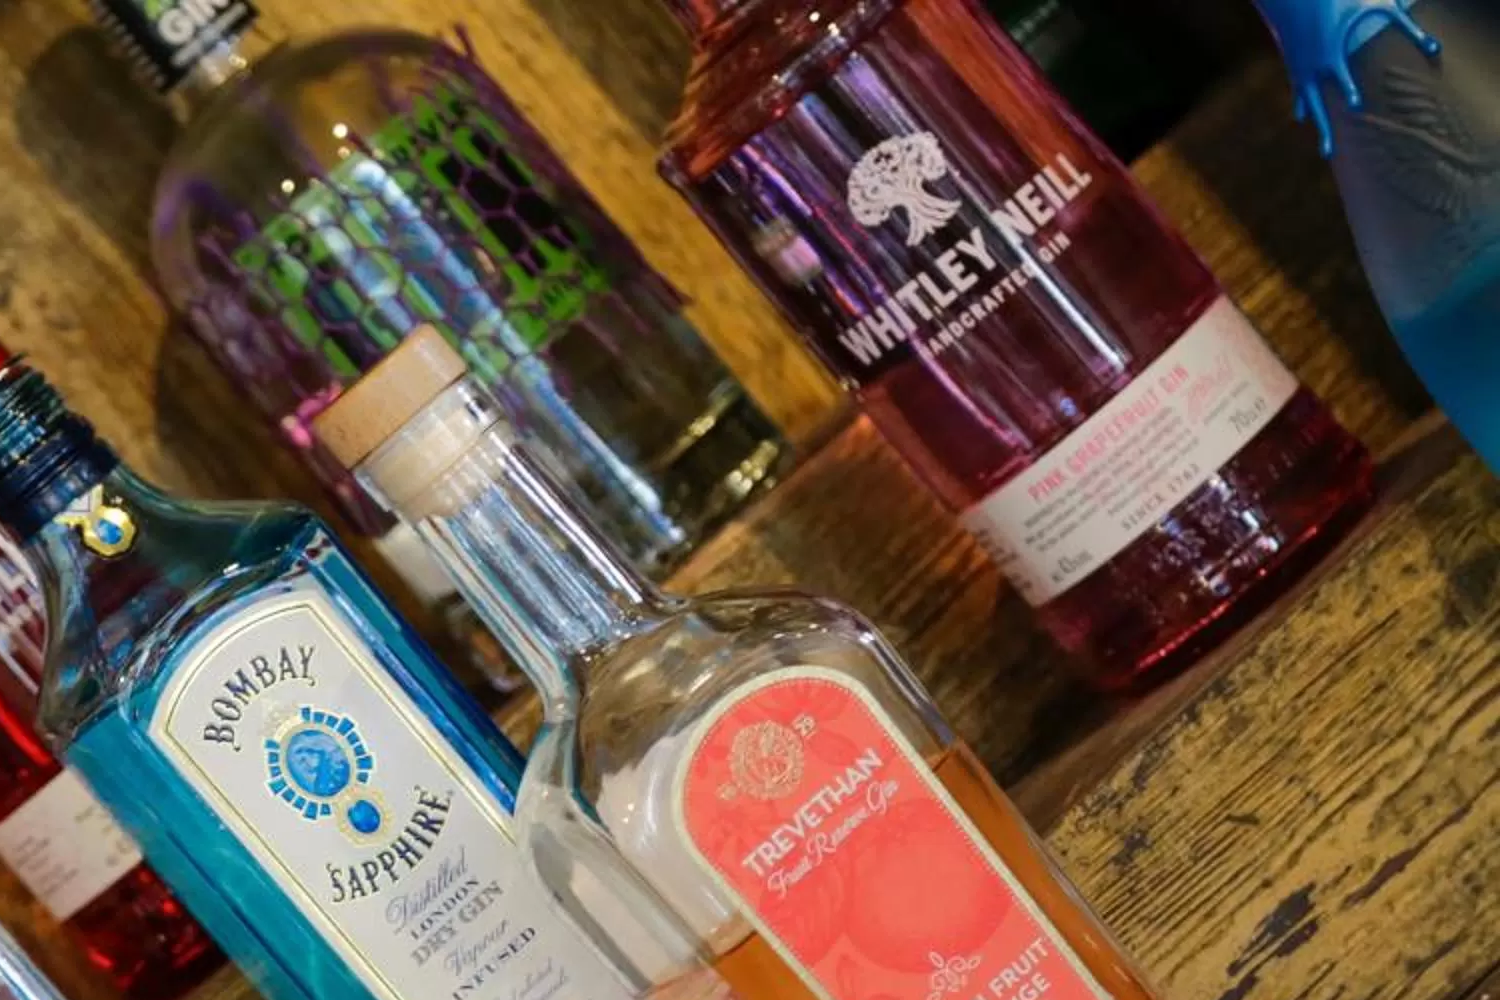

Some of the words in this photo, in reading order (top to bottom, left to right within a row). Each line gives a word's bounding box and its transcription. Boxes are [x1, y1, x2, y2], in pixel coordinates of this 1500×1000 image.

[837, 226, 1002, 368] WHITLEY
[988, 151, 1093, 249] NEILL
[1036, 230, 1073, 266] GIN
[1026, 466, 1066, 504] PINK
[203, 646, 314, 752] BOMBAY
[740, 745, 885, 877] TREVETHAN
[861, 776, 902, 814] Gin
[326, 784, 450, 901] SAPPHIRE
[407, 875, 479, 942] LONDON
[408, 917, 458, 967] DRY
[455, 878, 504, 924] GIN
[987, 936, 1051, 998] FRUIT
